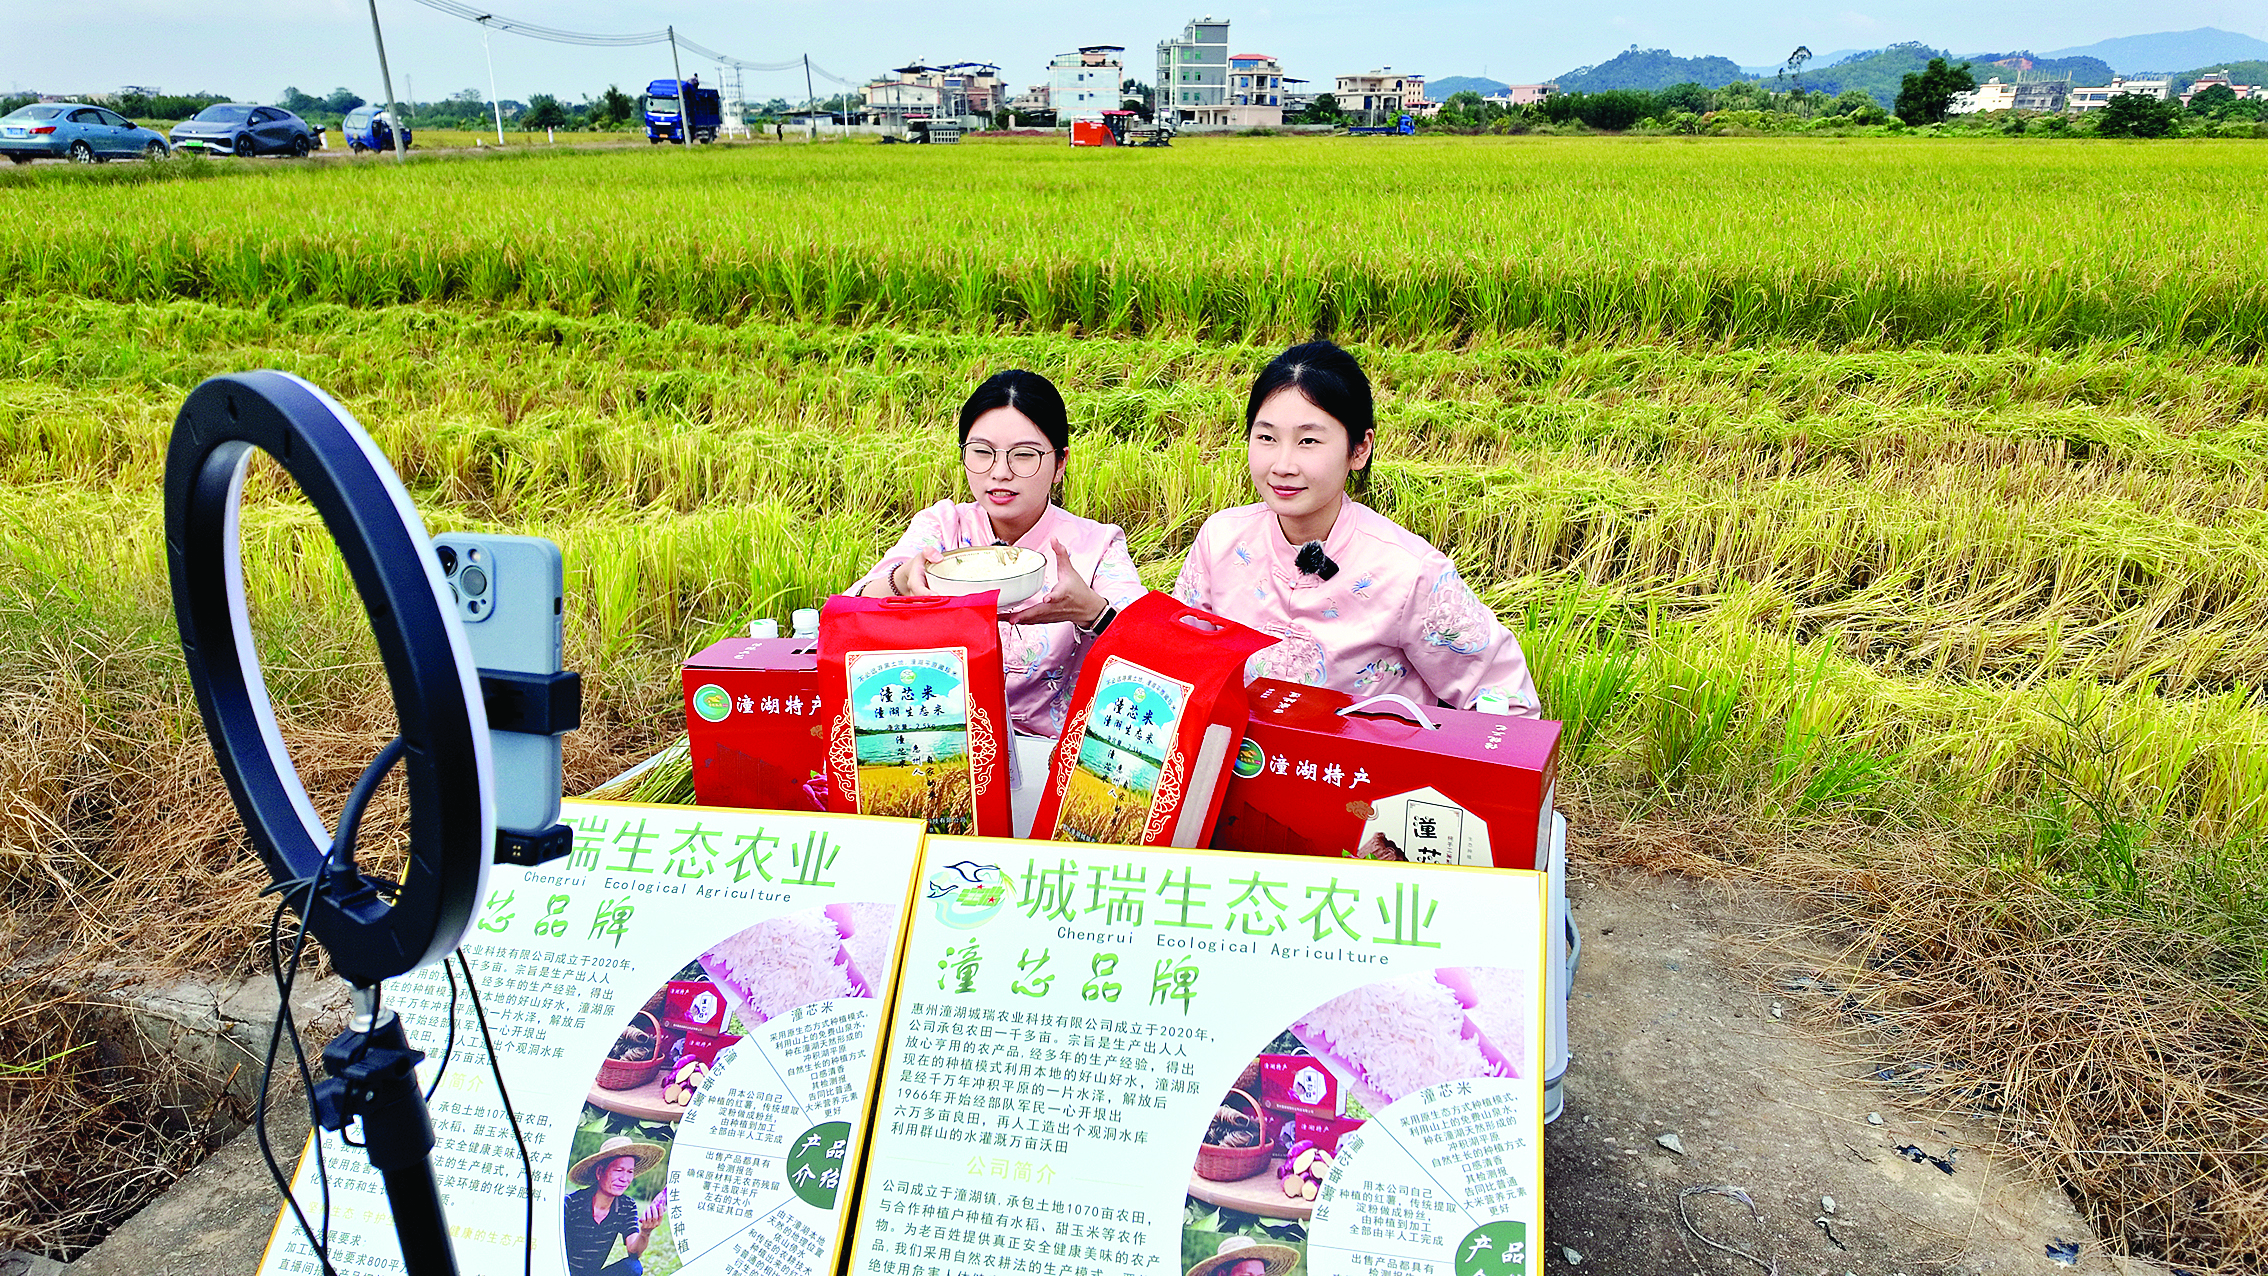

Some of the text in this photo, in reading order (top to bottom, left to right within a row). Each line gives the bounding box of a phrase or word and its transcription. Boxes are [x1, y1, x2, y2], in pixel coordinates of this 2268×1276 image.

[880, 684, 937, 703] 潼芯米
[736, 694, 822, 716] 潼湖特产
[874, 704, 945, 719] 潼湖生态米
[1113, 697, 1154, 726] 潼芯米
[1103, 714, 1154, 745] 潼湖生态米
[1269, 754, 1371, 789] 潼湖特产
[524, 871, 792, 903] Chengrui Ecological Agriculture
[1016, 857, 1442, 949] 城瑞生态农业
[1057, 926, 1389, 966] Chengrui Ecological Agriculture
[937, 937, 1200, 1017] 潼芯品牌
[791, 1001, 834, 1023] 潼芯米
[908, 1019, 1188, 1057] 公司承包农田一千多亩。宗旨是生产出人人
[788, 1050, 867, 1077] 自然生长的种植方式
[810, 1066, 845, 1080] 口感清香
[728, 1088, 783, 1103] 用本公司自己
[806, 1092, 858, 1112] 大米营养元素
[1421, 1081, 1472, 1105] 潼芯米
[824, 1107, 841, 1118] 更好
[720, 1118, 775, 1133] 由种植到加工
[1423, 1116, 1517, 1146] 种在潼湖天然形成的
[796, 1133, 847, 1159] 产品
[1432, 1138, 1526, 1168] 自然生长的种植方式
[1447, 1132, 1501, 1152] 冲积湖平原
[705, 1150, 770, 1169] 出售产品都具有
[717, 1162, 753, 1176] 检测报告
[966, 1154, 1057, 1185] 公司简介
[1461, 1155, 1503, 1173] 口感清香
[792, 1162, 840, 1190] 介绍
[1464, 1177, 1518, 1197] 告同比普通
[1466, 1167, 1508, 1185] 其检测报
[704, 1192, 750, 1207] 左右的大小
[1363, 1180, 1433, 1199] 用本公司自己
[1464, 1187, 1527, 1210] 大米营养元素
[668, 1170, 689, 1255] 原生态种植
[697, 1201, 754, 1219] 以保证其口感
[1488, 1204, 1510, 1217] 更好
[879, 1198, 1147, 1246] 与合作种植户种植有水稻、甜玉米等农作
[1361, 1215, 1432, 1233] 由种植到加工
[875, 1218, 1161, 1268] 物。为老百姓提供真正安全健康美味的农产
[1350, 1225, 1444, 1246] 全部由半人工完成
[1464, 1234, 1525, 1265] 产品
[1352, 1253, 1435, 1275] 出售产品都具有
